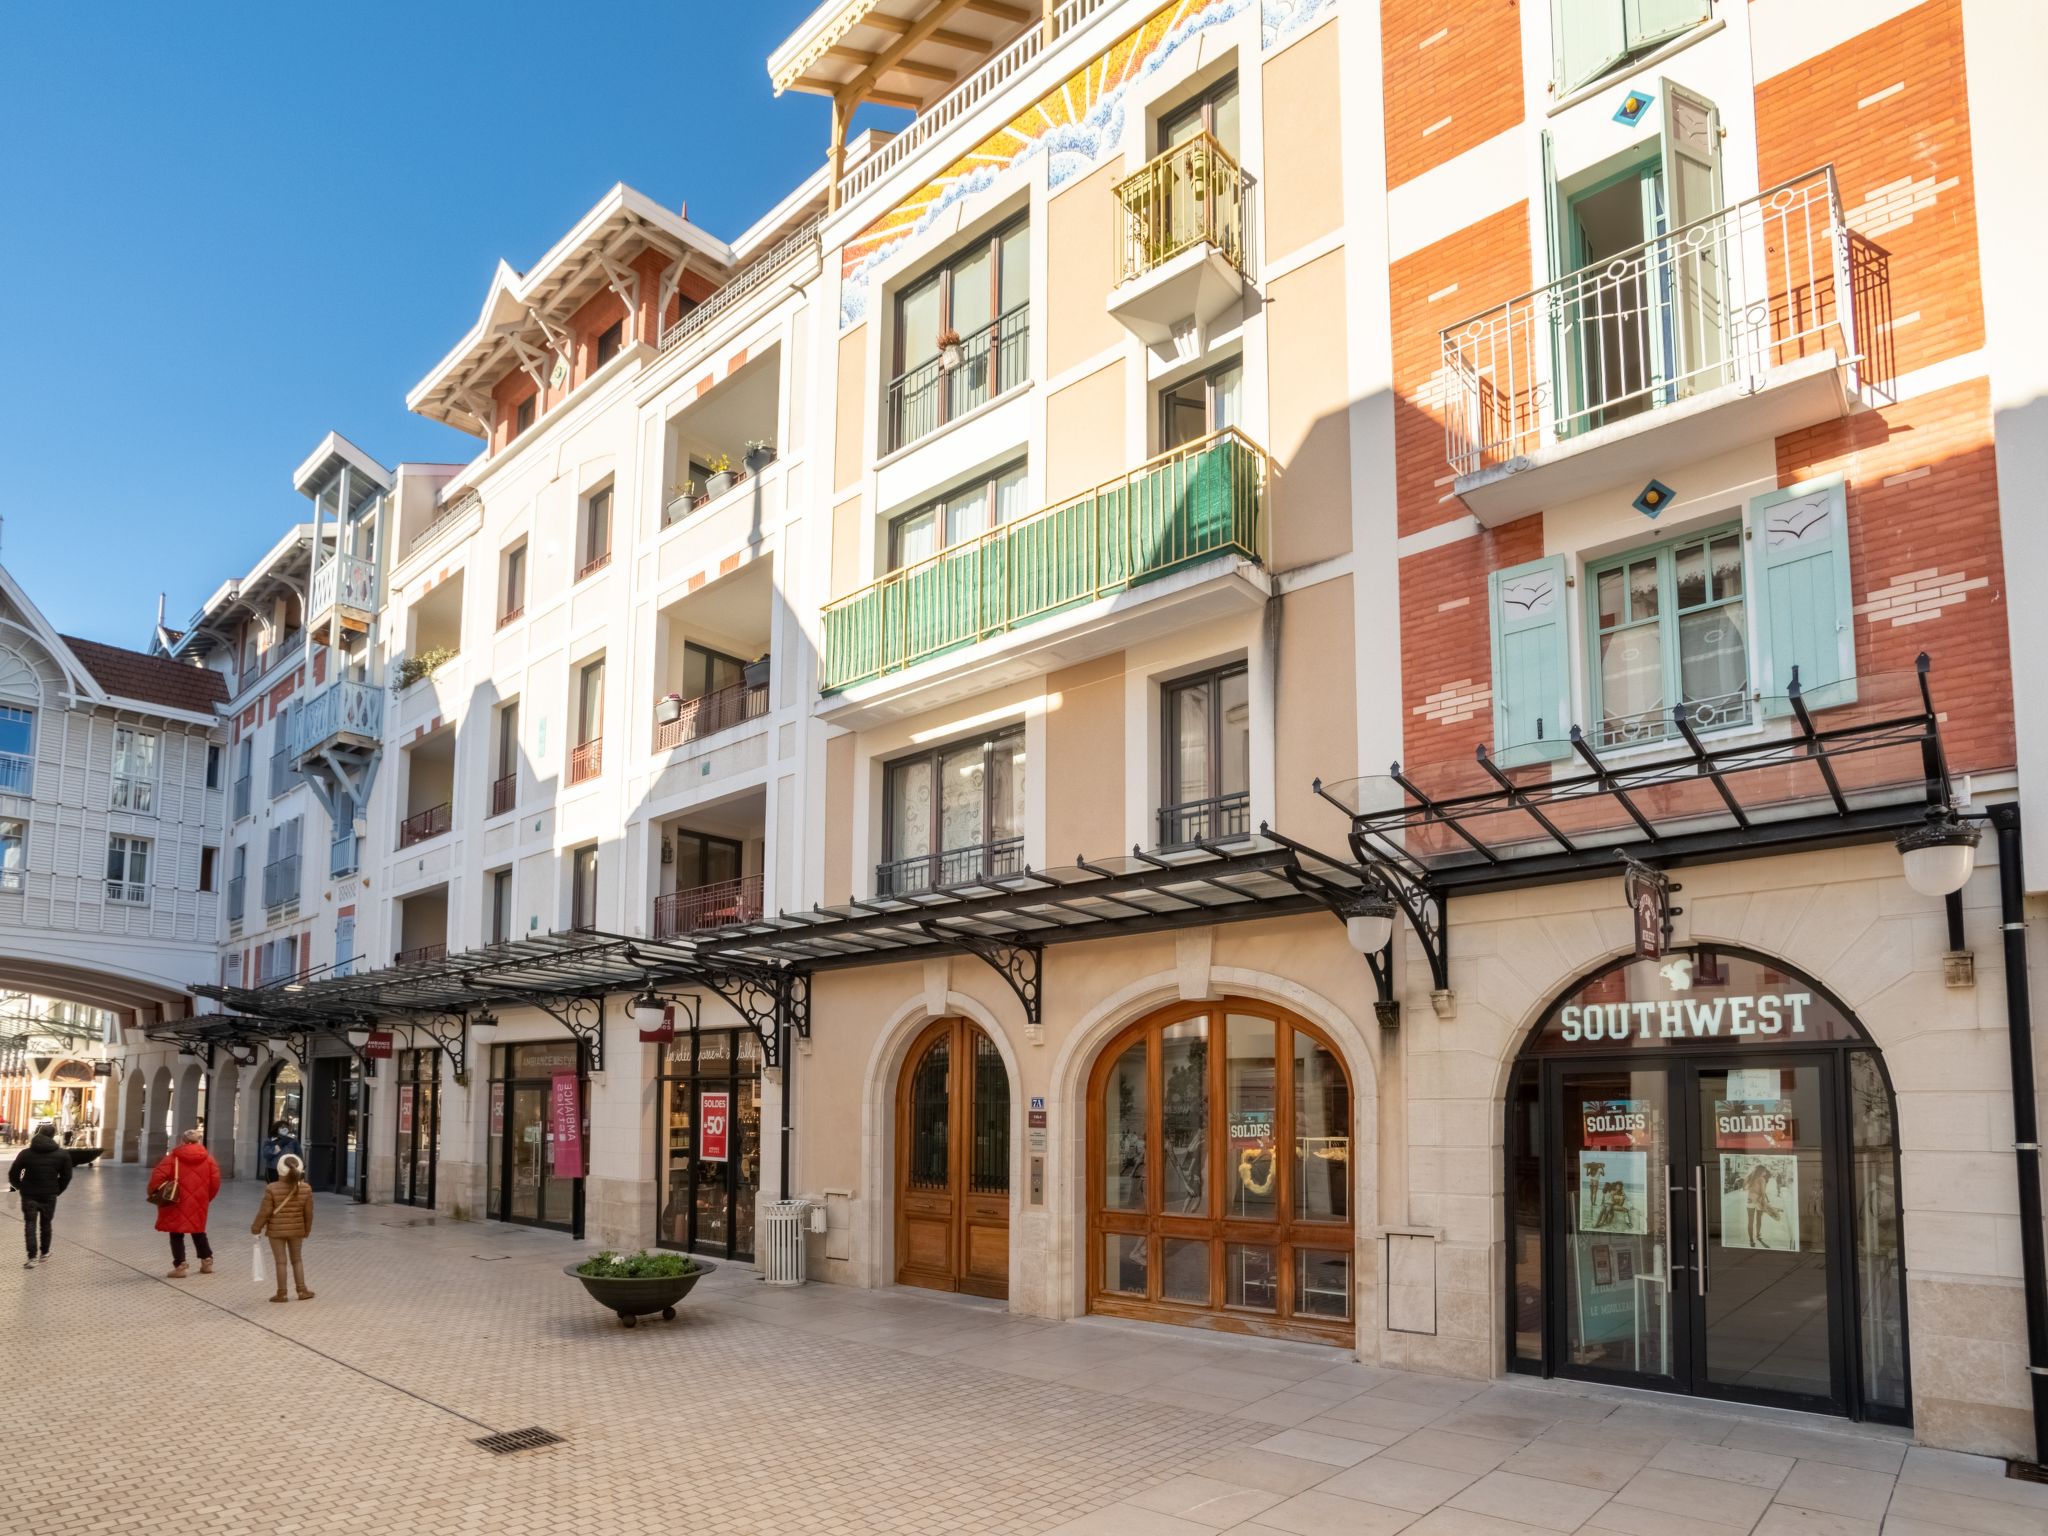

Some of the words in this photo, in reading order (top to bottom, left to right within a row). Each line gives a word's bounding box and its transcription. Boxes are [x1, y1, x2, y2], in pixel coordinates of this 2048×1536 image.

[1561, 993, 1811, 1042] SOUTHWEST
[704, 1099, 726, 1108] SOLDES
[1032, 1099, 1042, 1109] 7A
[1231, 1123, 1271, 1138] SOLDES
[1587, 1113, 1646, 1133] SOLDES
[1719, 1113, 1787, 1134] SOLDES
